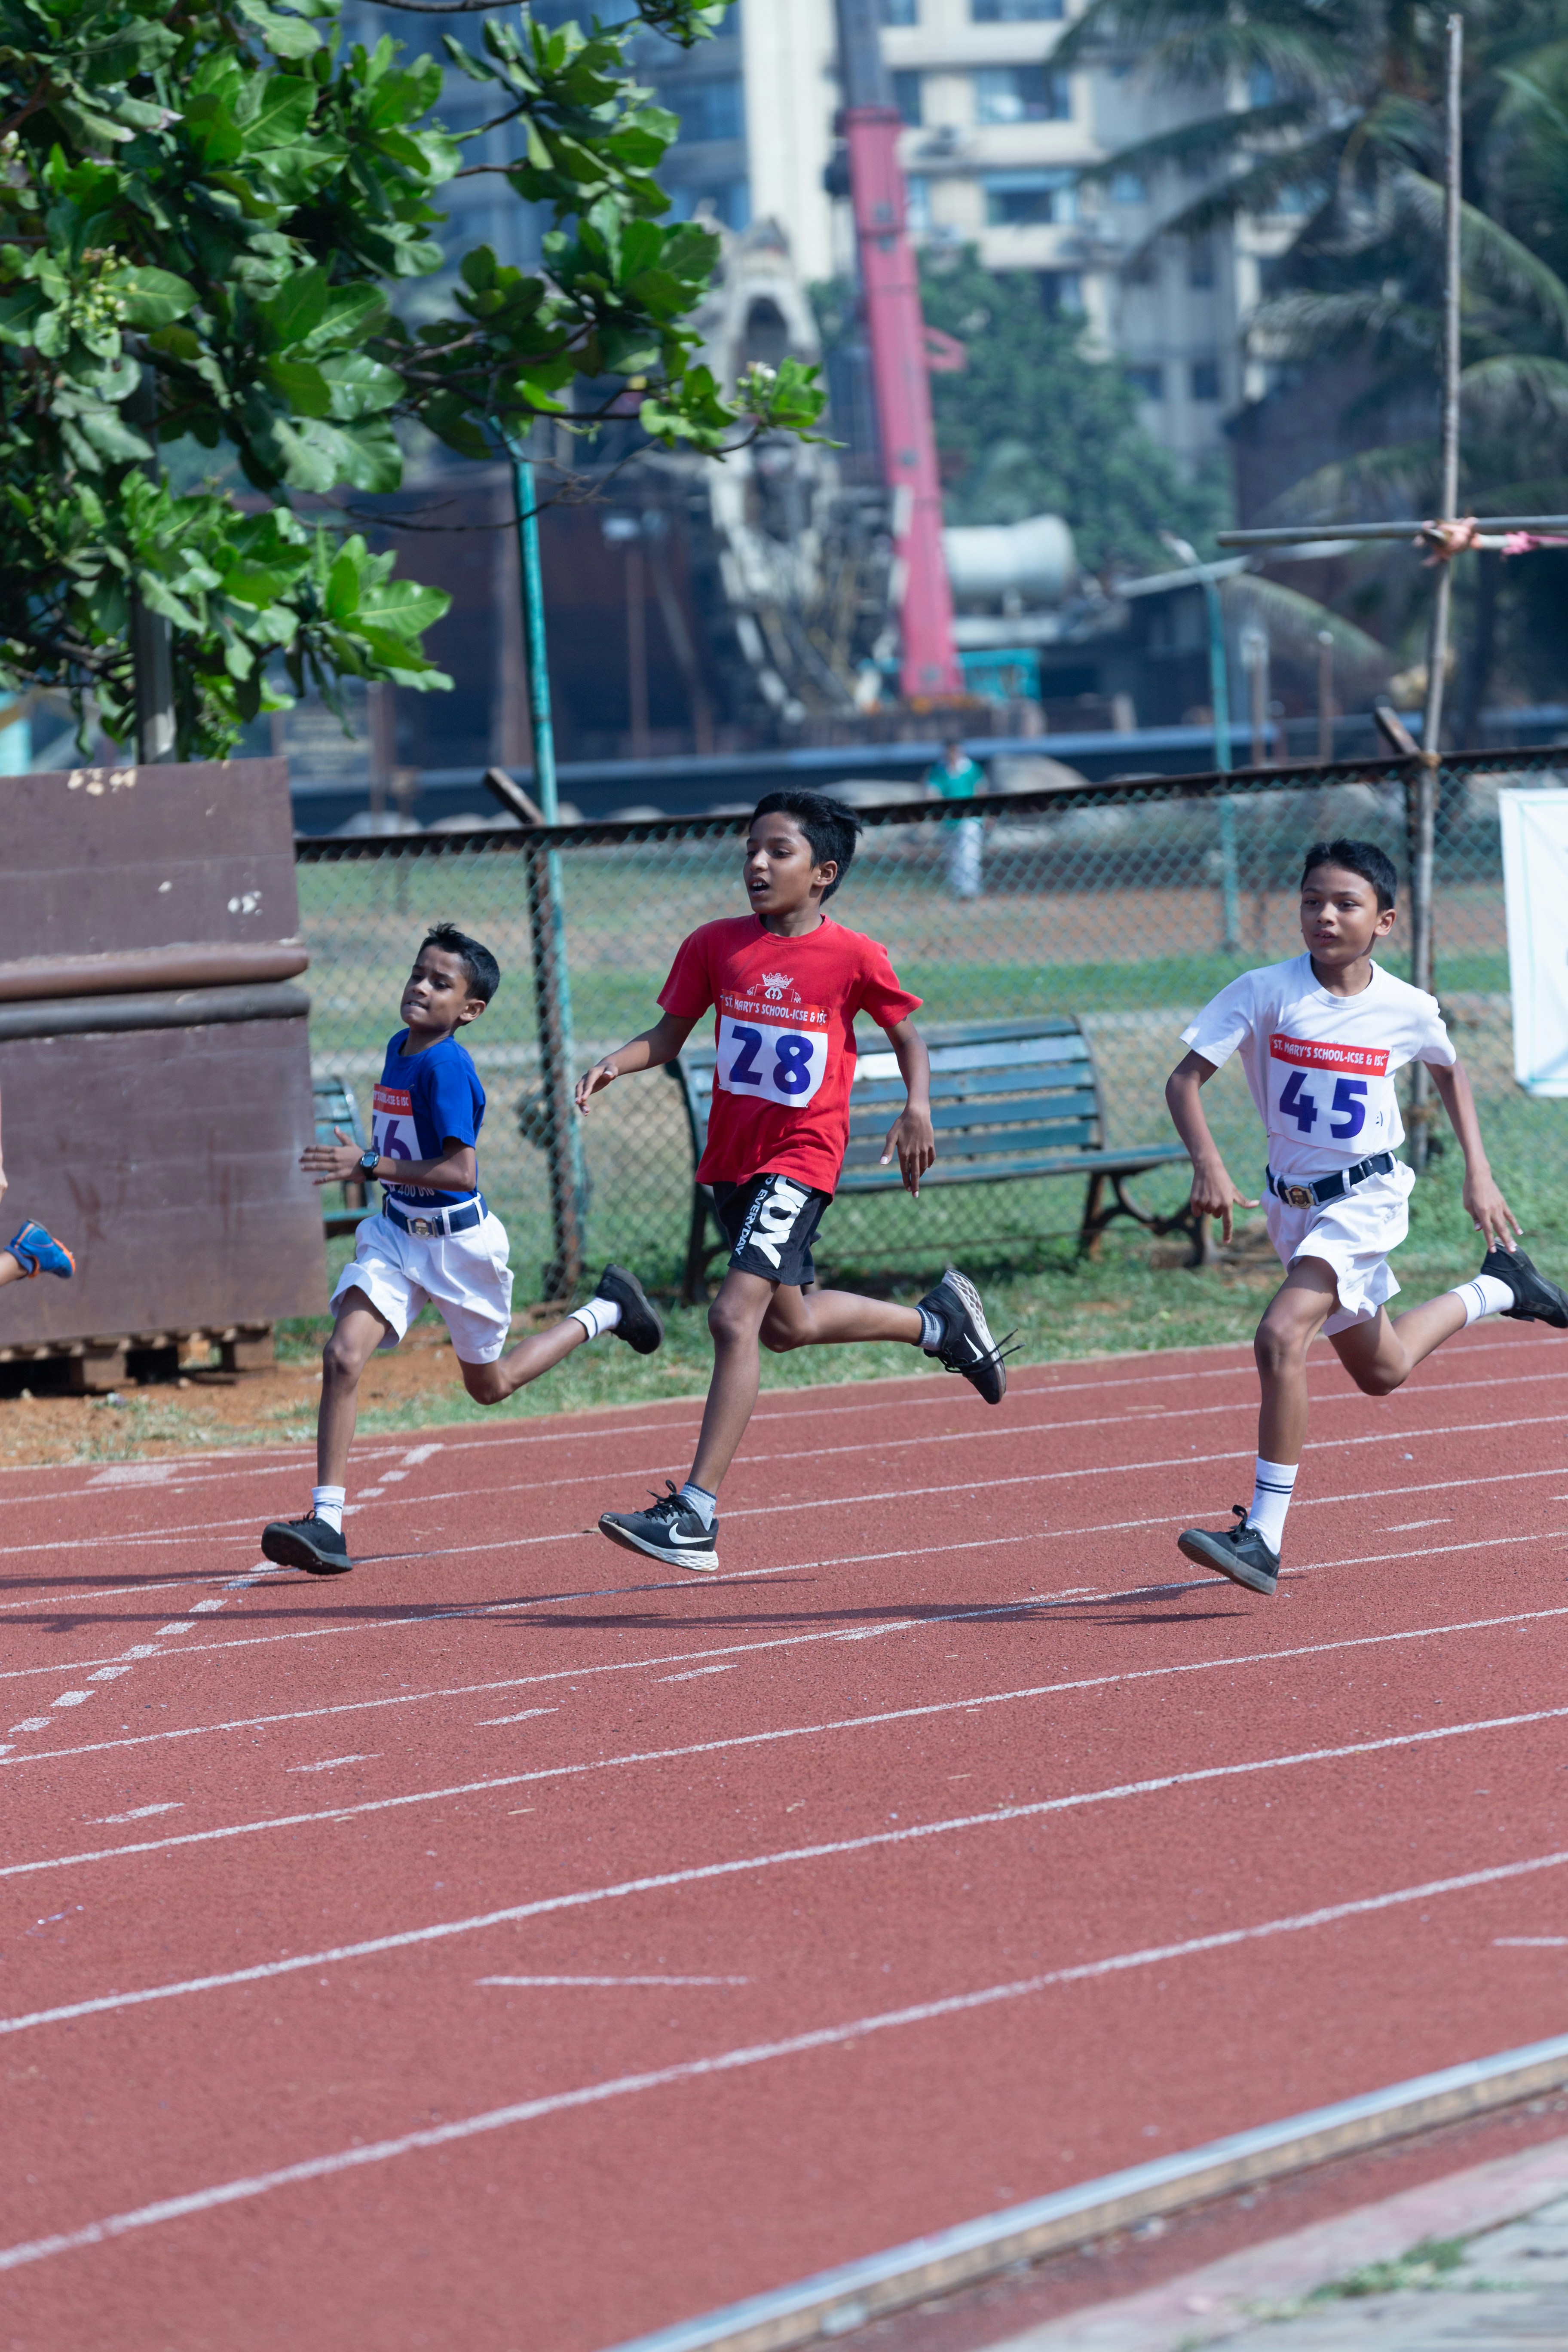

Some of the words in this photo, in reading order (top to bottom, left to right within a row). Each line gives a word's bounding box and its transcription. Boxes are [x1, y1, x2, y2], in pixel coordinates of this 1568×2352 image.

[725, 996, 733, 1008] ST.
[735, 999, 760, 1014] MARY'S
[761, 1004, 808, 1022] SCHOOL-ICSE
[809, 1012, 815, 1023] &
[816, 1012, 827, 1024] ISC
[729, 1025, 814, 1095] 28
[1273, 1039, 1283, 1051] ST.
[1284, 1042, 1312, 1057] MARY'S
[1313, 1047, 1364, 1065] SCHOOL-ICSE
[1366, 1054, 1372, 1066] &
[1279, 1070, 1368, 1139] 45
[397, 1184, 416, 1197] 400
[765, 1173, 777, 1185] D
[735, 1188, 769, 1256] EVERYDAY
